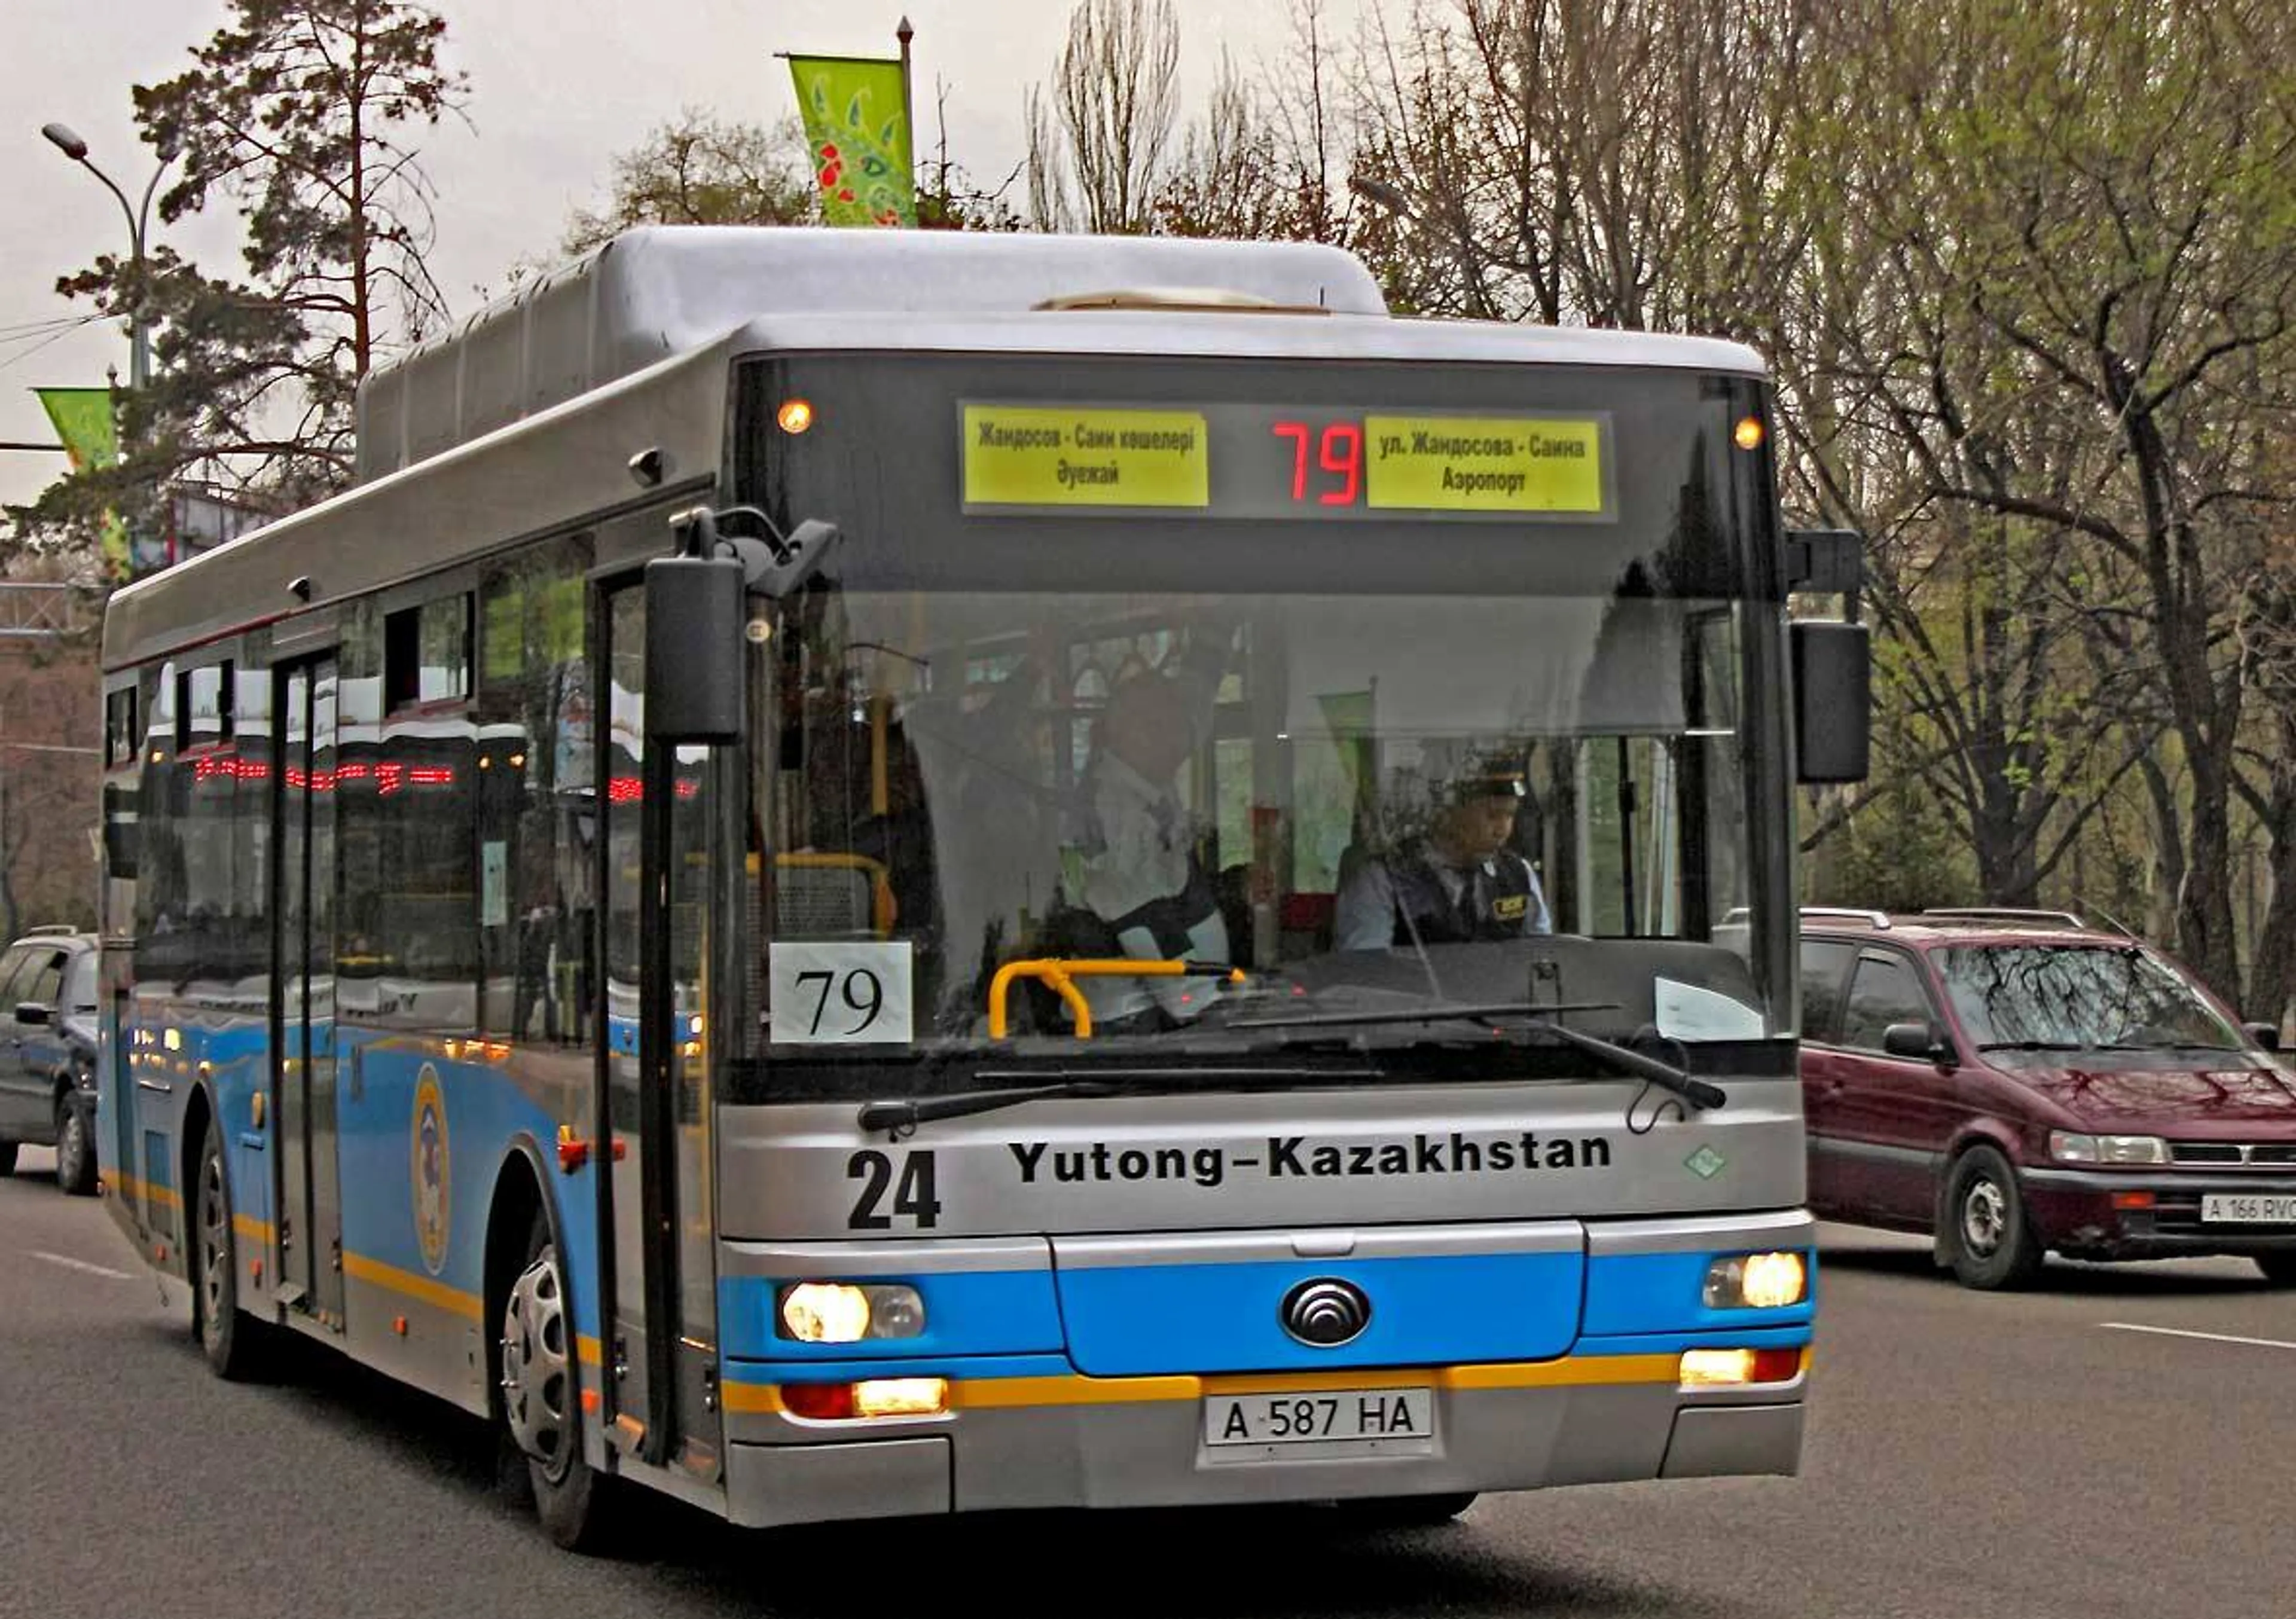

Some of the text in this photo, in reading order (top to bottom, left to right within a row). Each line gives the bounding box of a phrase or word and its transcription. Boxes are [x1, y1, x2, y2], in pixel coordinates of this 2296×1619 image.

[979, 421, 1061, 451] Жандосов
[1379, 435, 1407, 460] ул.
[1412, 431, 1515, 460] Жандосова
[1272, 421, 1361, 506] 79
[1442, 466, 1525, 497] Аэропорт
[795, 968, 883, 1036] 79
[847, 1150, 941, 1230] 24
[2211, 1199, 2221, 1217] A
[2228, 1199, 2258, 1218] 166
[1223, 1396, 1413, 1438] A 587 HA
